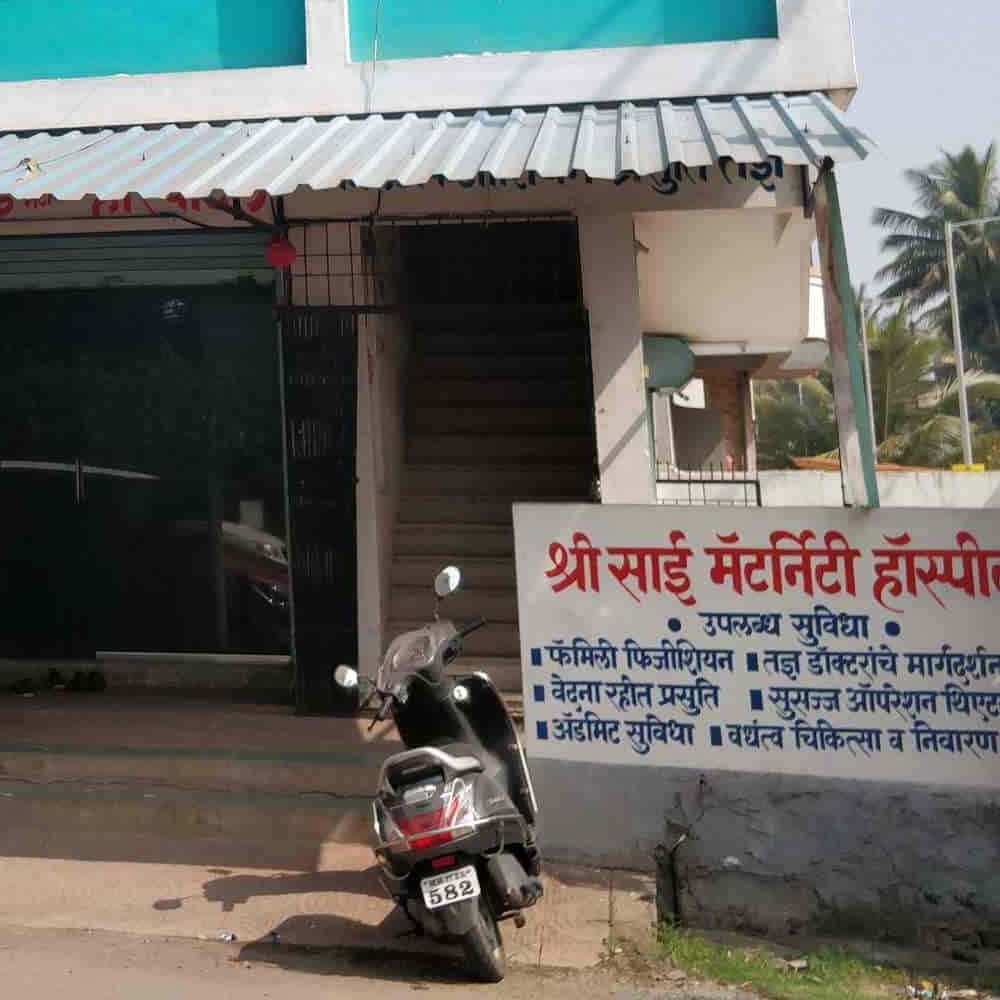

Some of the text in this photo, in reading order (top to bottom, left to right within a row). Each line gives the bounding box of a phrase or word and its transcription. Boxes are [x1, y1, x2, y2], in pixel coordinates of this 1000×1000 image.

[546, 531, 601, 595] श्री
[606, 530, 697, 606] साई
[704, 530, 862, 597] मॅटर्निटी
[699, 605, 870, 646] उपलब्ध सुविधा
[545, 637, 734, 675] फॅमिली फिजीशियन
[763, 650, 801, 681] तज्ञ
[807, 644, 898, 681] डॉक्टरांचे
[604, 674, 653, 711] रहीत
[658, 677, 720, 716] प्रसुति
[768, 687, 841, 720] सुसज्ज
[624, 714, 695, 754] सुविधा
[790, 718, 881, 758] चिकित्सा
[887, 730, 905, 753] व
[909, 721, 998, 760] निवारण
[430, 880, 475, 905] 582
